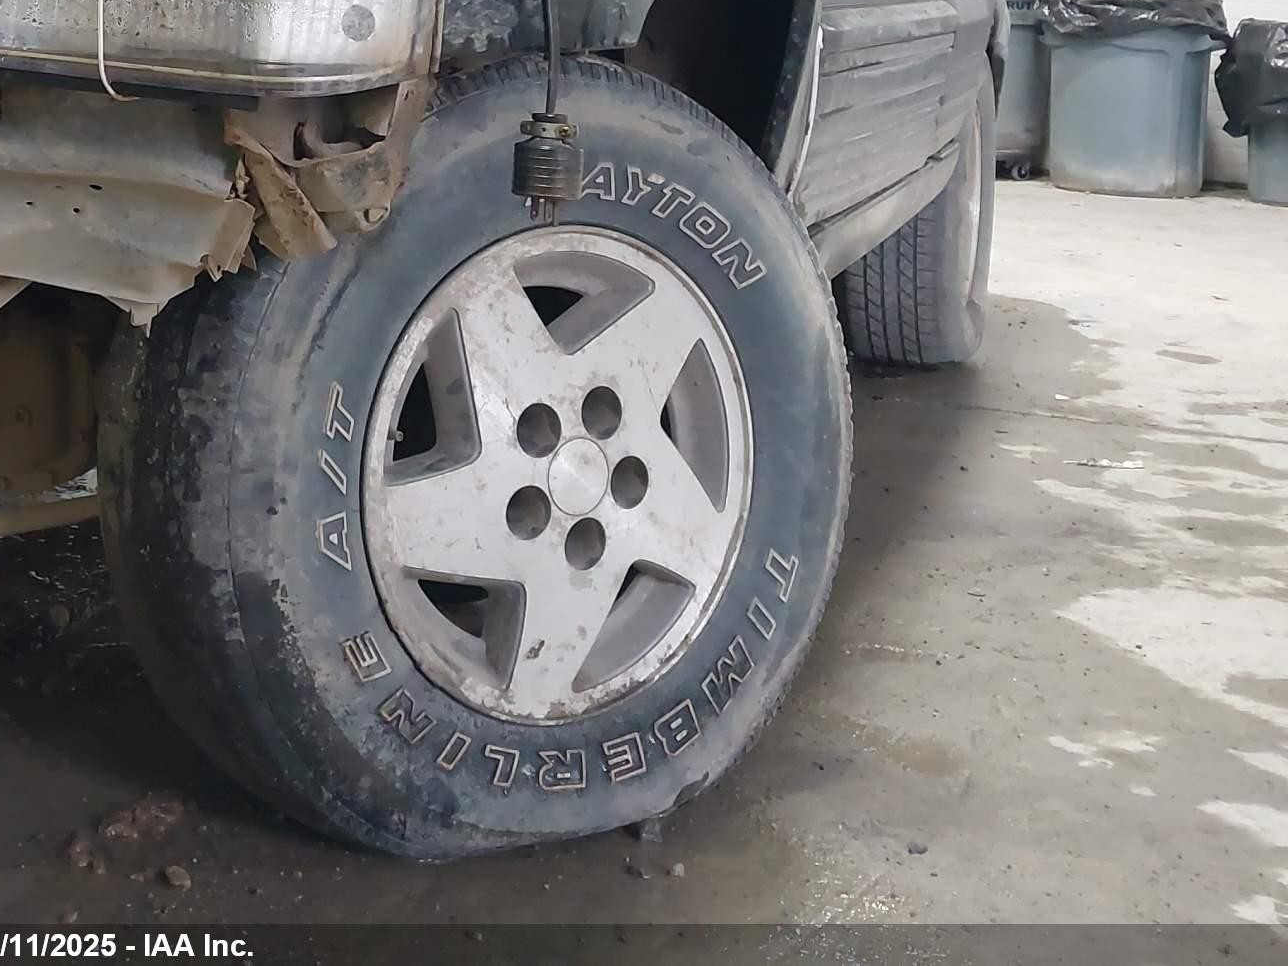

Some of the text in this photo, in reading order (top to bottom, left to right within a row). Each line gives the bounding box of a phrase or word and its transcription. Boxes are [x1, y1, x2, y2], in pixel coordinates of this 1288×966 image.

[1006, 0, 1033, 11] RUT
[578, 161, 768, 290] AYTON
[342, 548, 799, 794] TIMBERLINE
